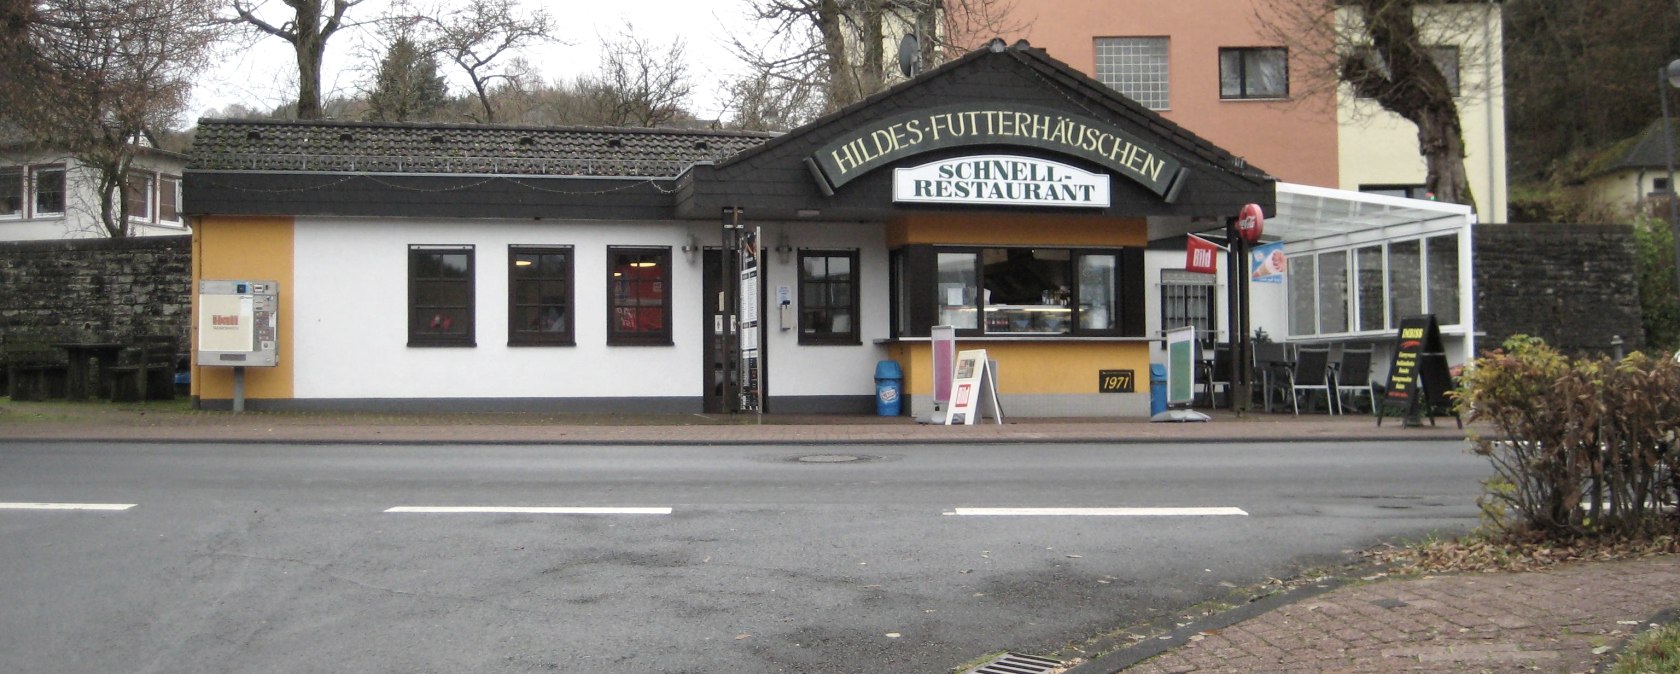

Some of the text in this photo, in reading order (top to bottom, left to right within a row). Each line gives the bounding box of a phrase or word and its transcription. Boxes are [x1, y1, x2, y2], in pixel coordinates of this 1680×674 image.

[832, 111, 1165, 182] HILDES-FUTTERHÄUSCHEN
[938, 160, 1072, 182] SCHNELL-
[914, 179, 1096, 202] RESTAURANT
[1192, 248, 1212, 268] Bild
[1104, 376, 1129, 389] 1971
